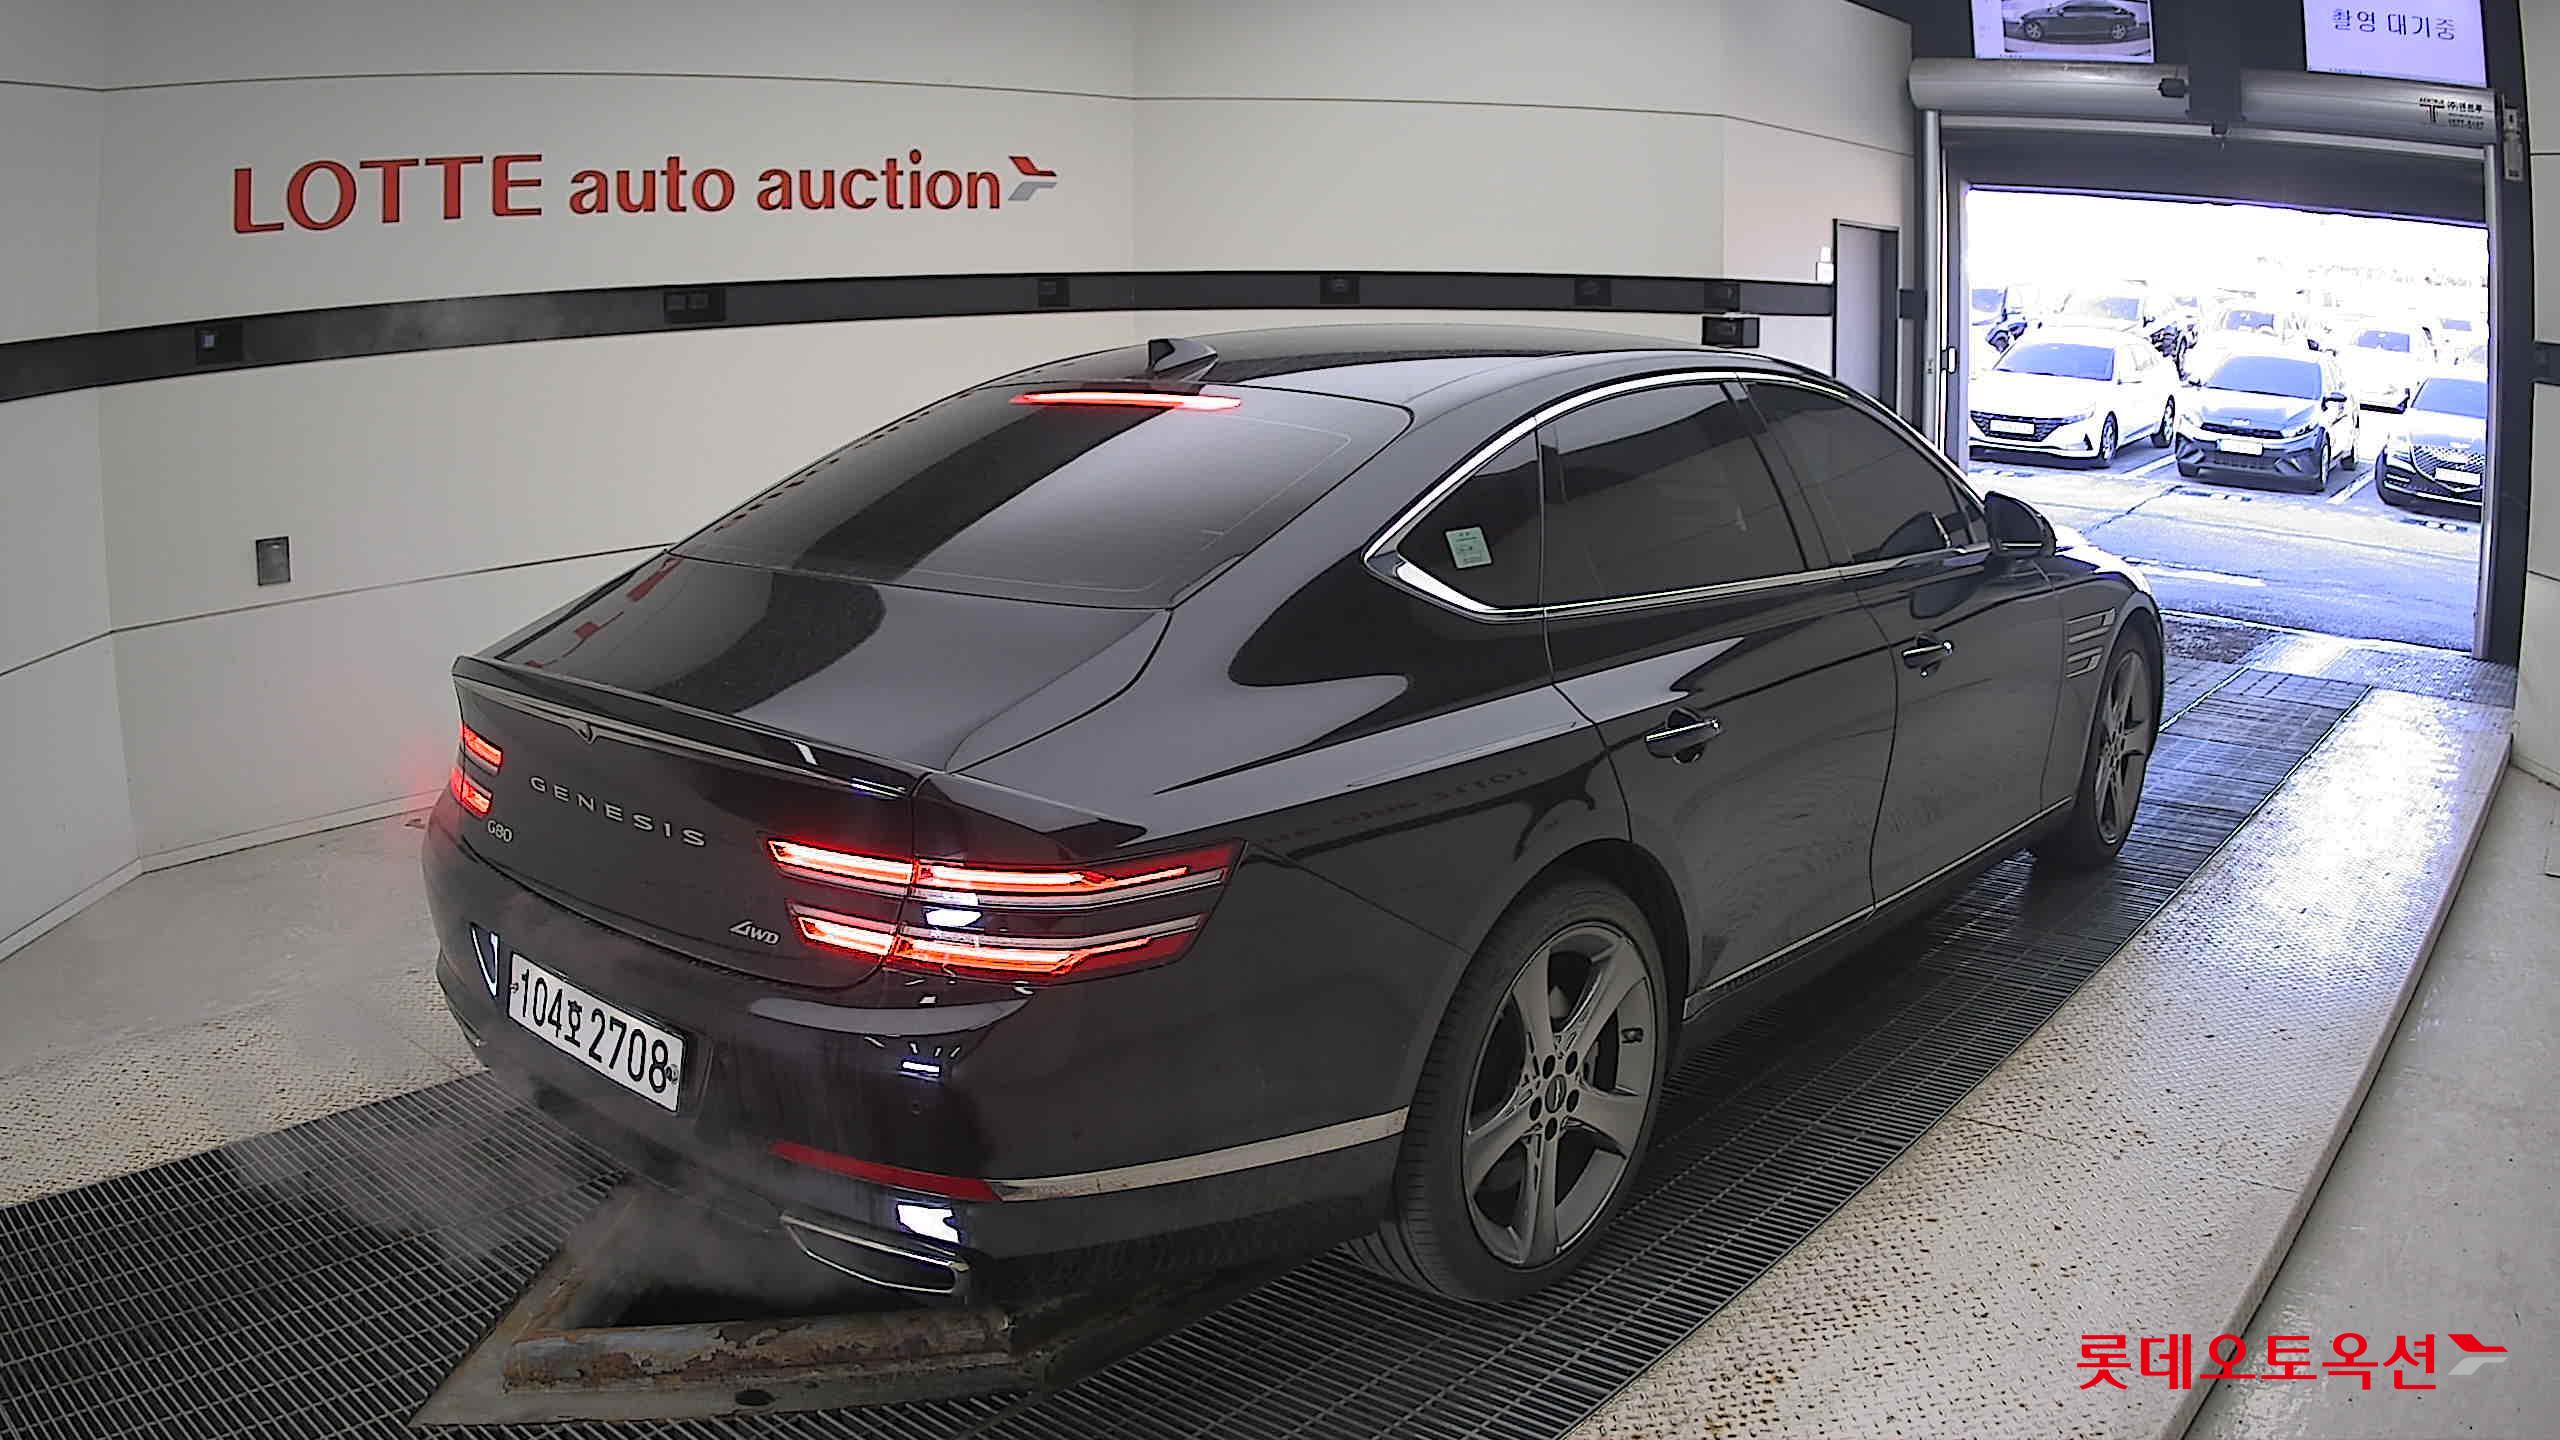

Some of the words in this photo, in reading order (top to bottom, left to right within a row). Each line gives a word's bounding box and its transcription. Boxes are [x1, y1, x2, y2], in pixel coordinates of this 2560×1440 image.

[2332, 8, 2376, 33] 촬영
[2387, 13, 2456, 41] 대기중
[234, 155, 541, 233] LOTTE
[569, 157, 736, 214] auto
[757, 149, 1002, 210] auction
[487, 820, 514, 843] G80
[529, 776, 707, 847] GENESIS
[730, 921, 780, 945] AWD
[588, 1007, 679, 1094] 2708
